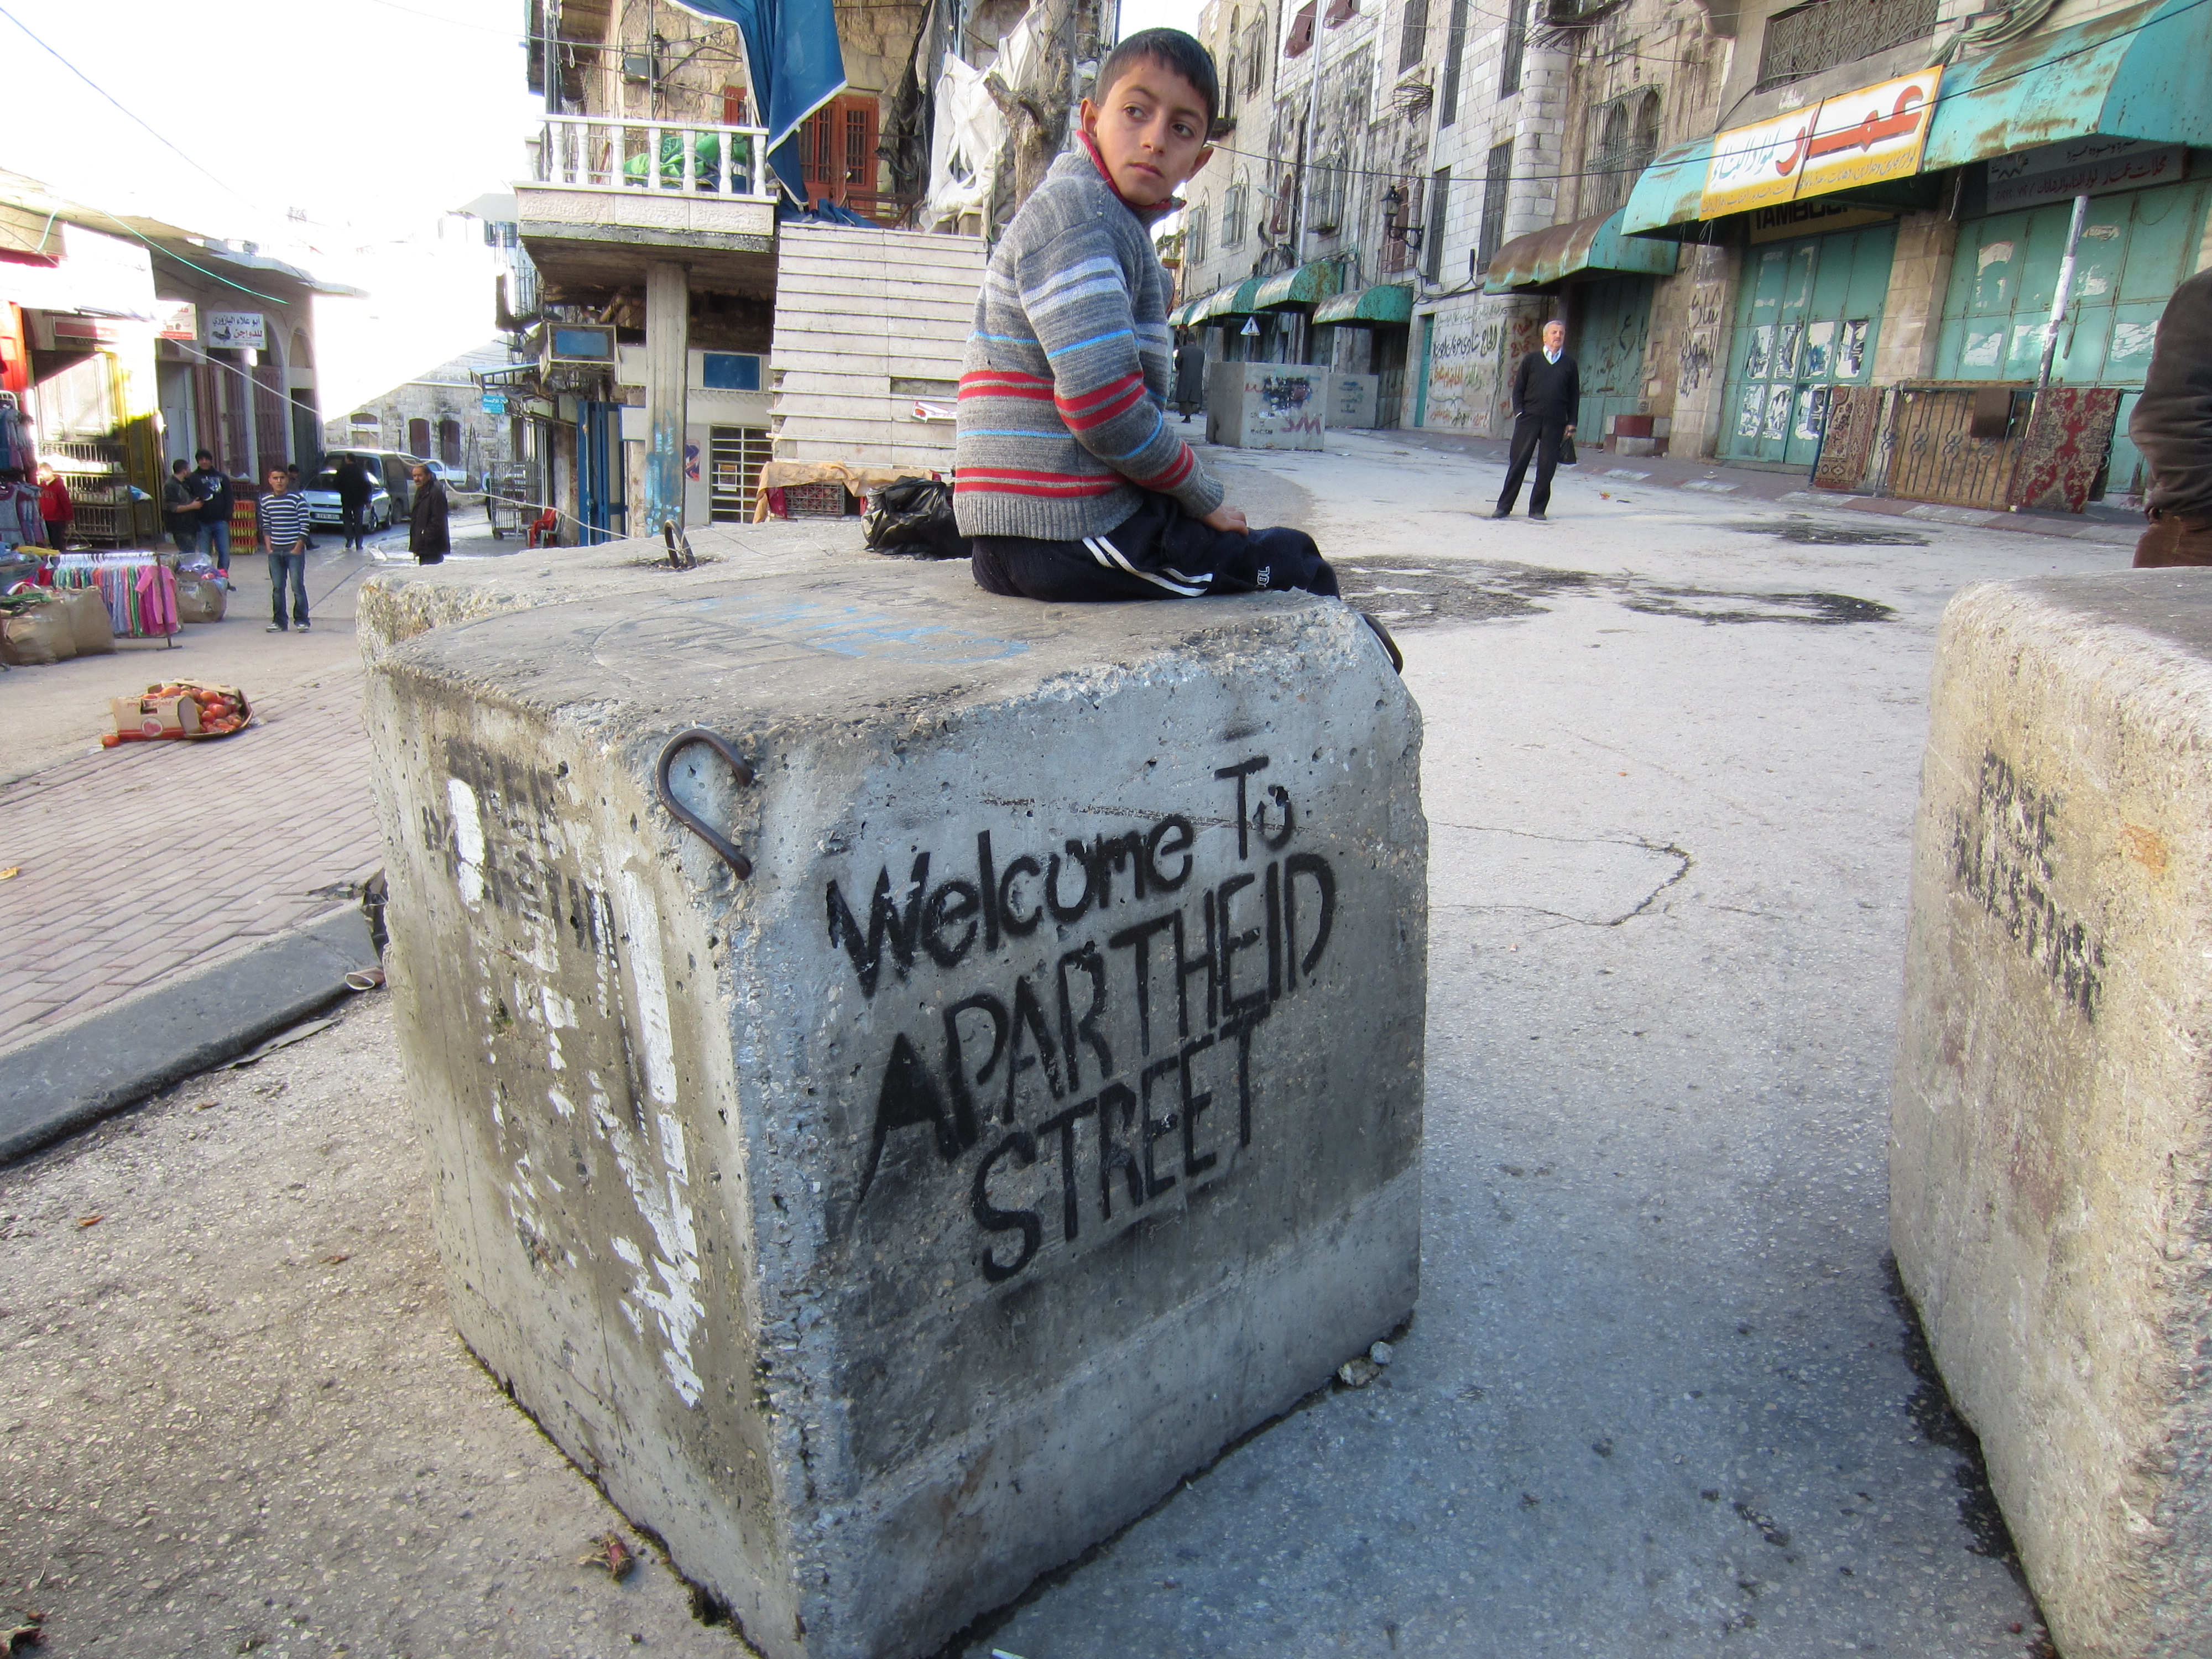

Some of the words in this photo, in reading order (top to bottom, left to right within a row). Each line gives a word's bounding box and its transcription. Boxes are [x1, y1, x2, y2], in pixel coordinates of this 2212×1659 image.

[1776, 85, 1924, 176] عمار
[826, 814, 1193, 999] Welcome
[1214, 755, 1293, 861] To
[857, 852, 1337, 1202] APARTHEID
[971, 1010, 1265, 1283] STREET
